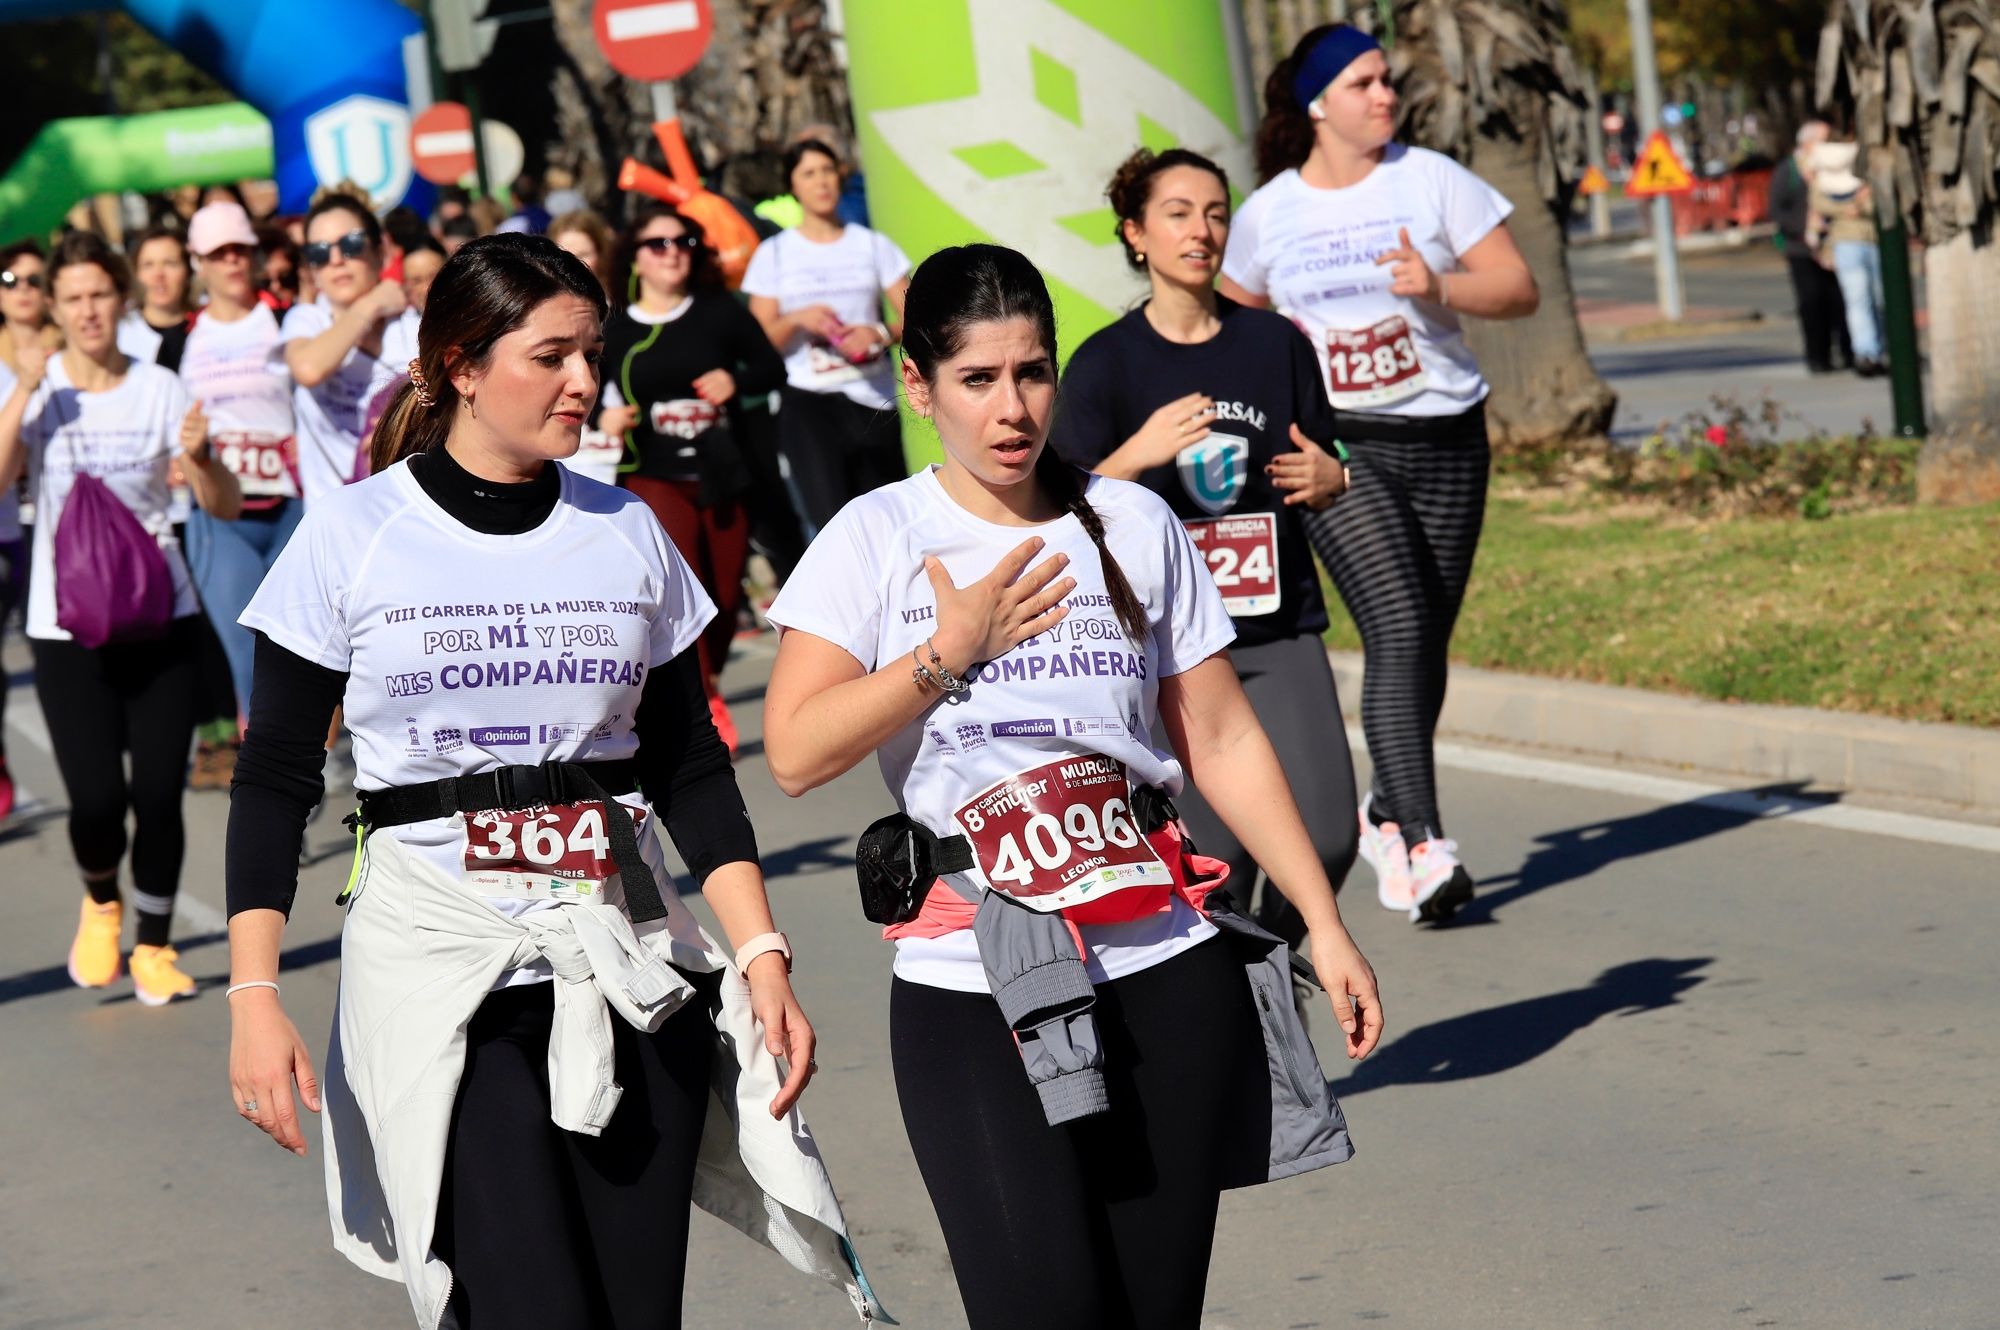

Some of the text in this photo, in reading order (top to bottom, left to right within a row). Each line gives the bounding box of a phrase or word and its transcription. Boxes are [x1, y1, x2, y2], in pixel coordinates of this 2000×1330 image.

[1331, 337, 1417, 385] 1283
[1215, 519, 1268, 534] MURCIA
[1200, 545, 1273, 587] 24
[385, 607, 416, 625] VIII
[421, 604, 499, 619] CARRERA
[504, 603, 526, 616] DE
[531, 602, 552, 615] LA
[557, 600, 607, 613] MUJER
[901, 605, 934, 624] VIII
[424, 617, 618, 655] POR MÍ Y POR
[1070, 618, 1122, 641] POR
[386, 651, 645, 698] MIS COMPAÑERAS
[436, 740, 464, 753] Murcia
[961, 736, 987, 750] Murcia
[1060, 758, 1120, 780] MURCIA
[1072, 779, 1082, 788] DE
[1082, 775, 1107, 786] MARZO
[979, 784, 1013, 809] carrera
[992, 778, 1048, 818] mujer
[472, 808, 610, 865] 364
[989, 798, 1139, 886] 4096
[553, 869, 586, 878] CRIS
[1059, 855, 1109, 884] LEONOR
